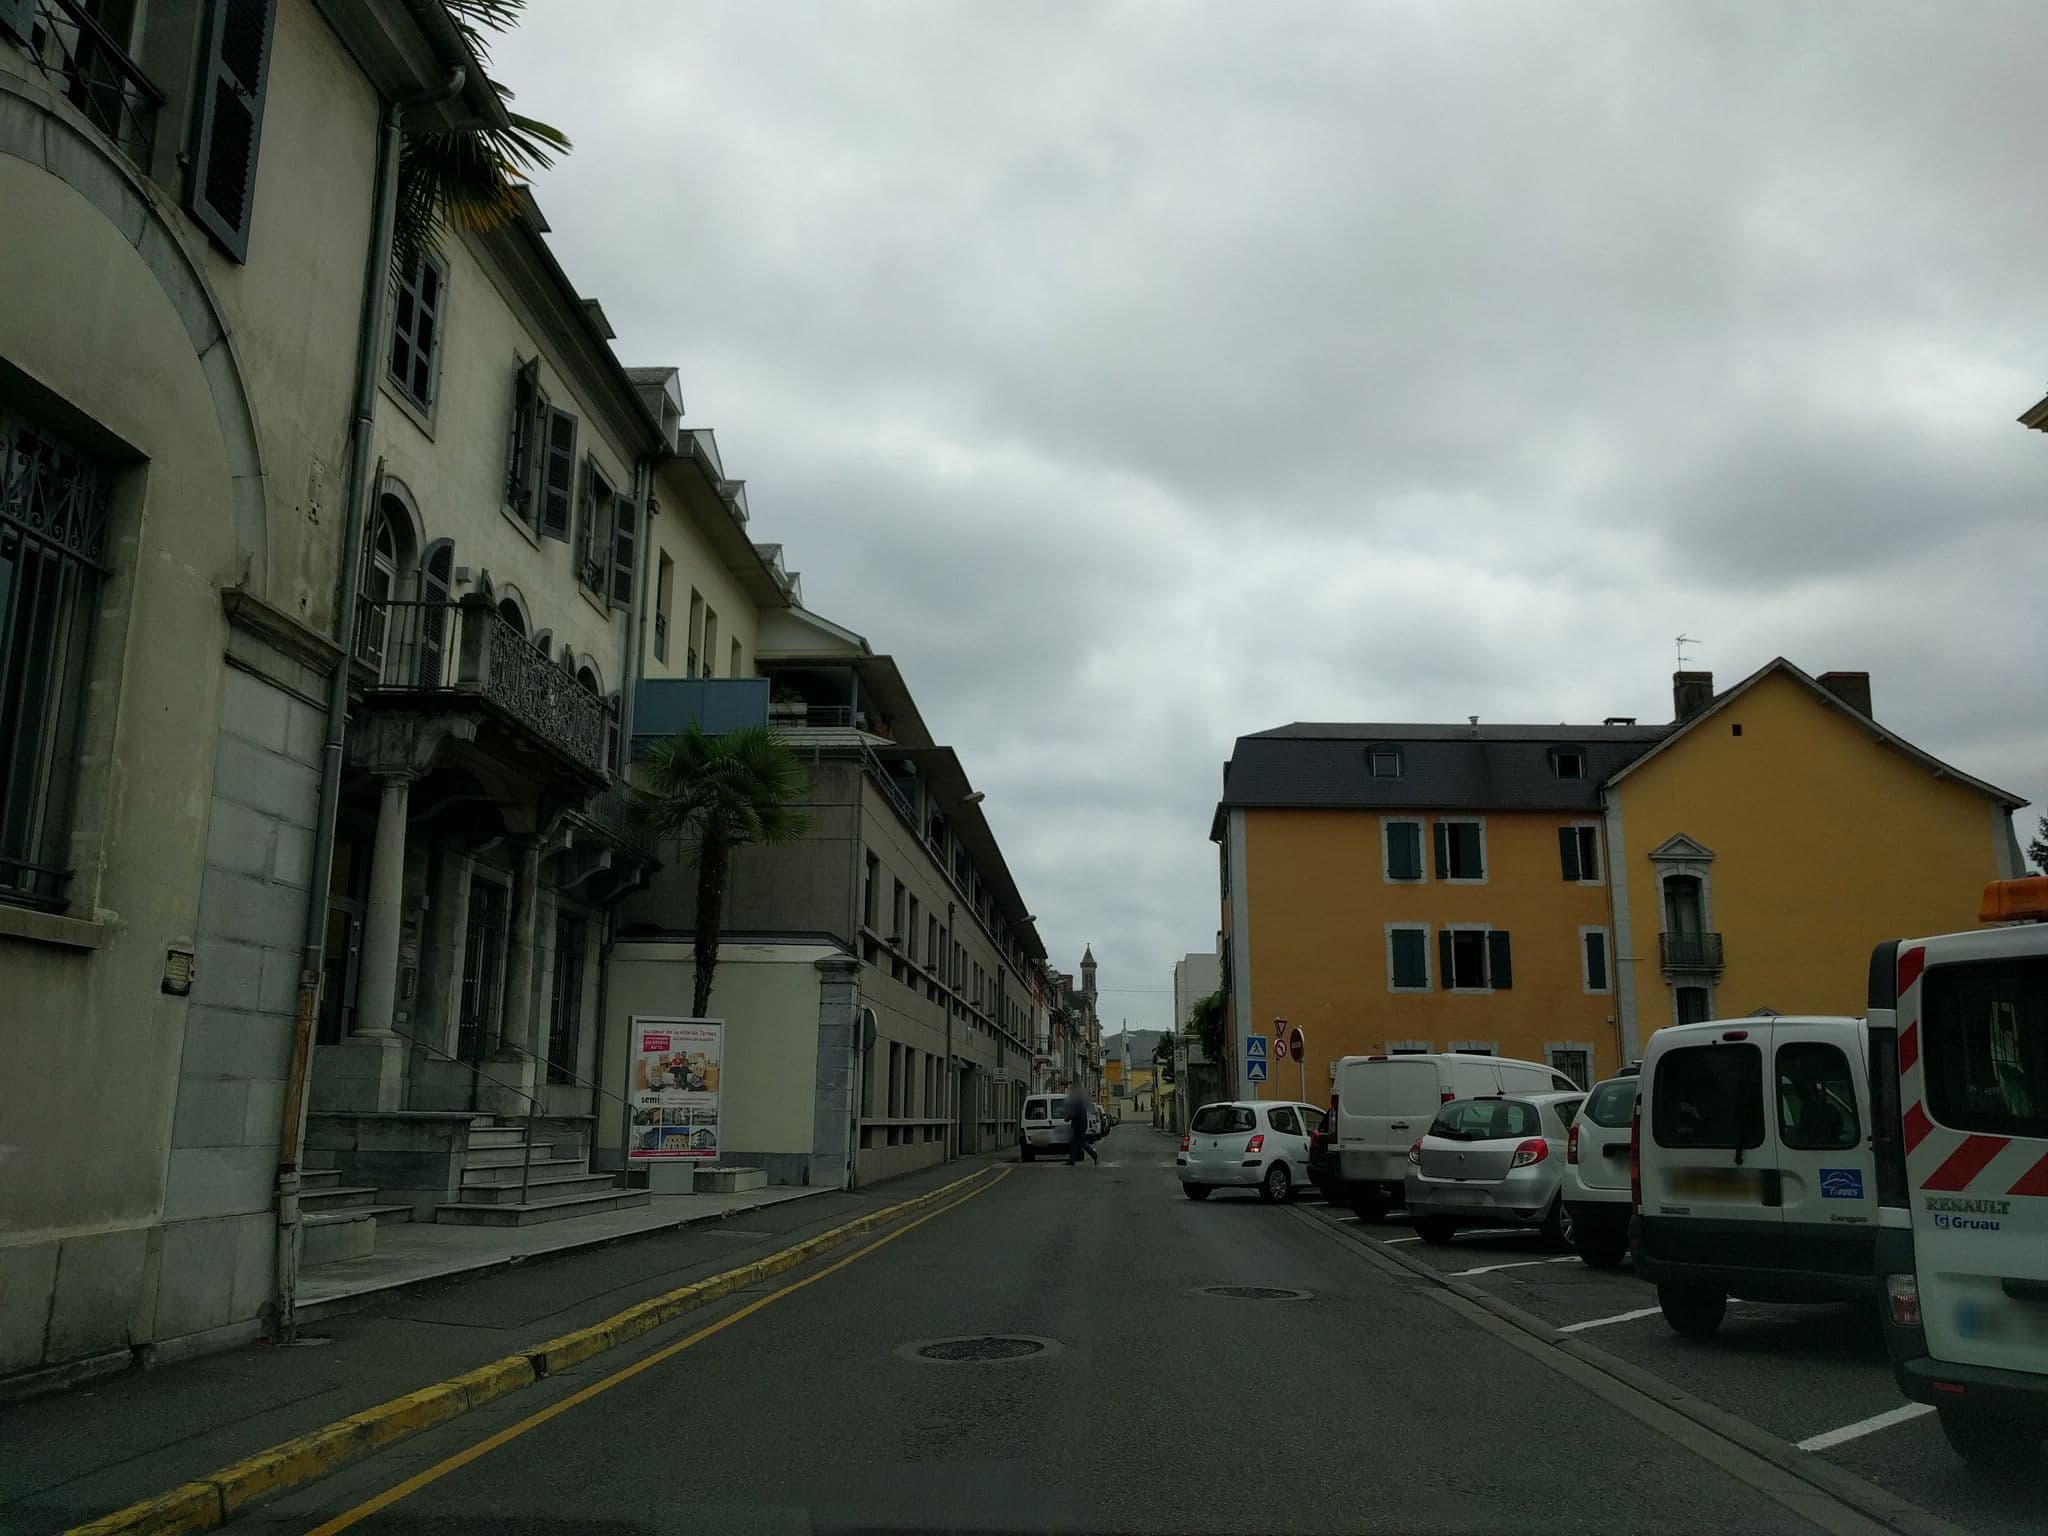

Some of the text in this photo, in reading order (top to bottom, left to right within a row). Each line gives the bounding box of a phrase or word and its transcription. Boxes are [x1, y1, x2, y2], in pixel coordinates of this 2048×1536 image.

[641, 1095, 660, 1104] semi
[1925, 1197, 2010, 1214] RENAULT
[1952, 1216, 2000, 1231] Gruau
